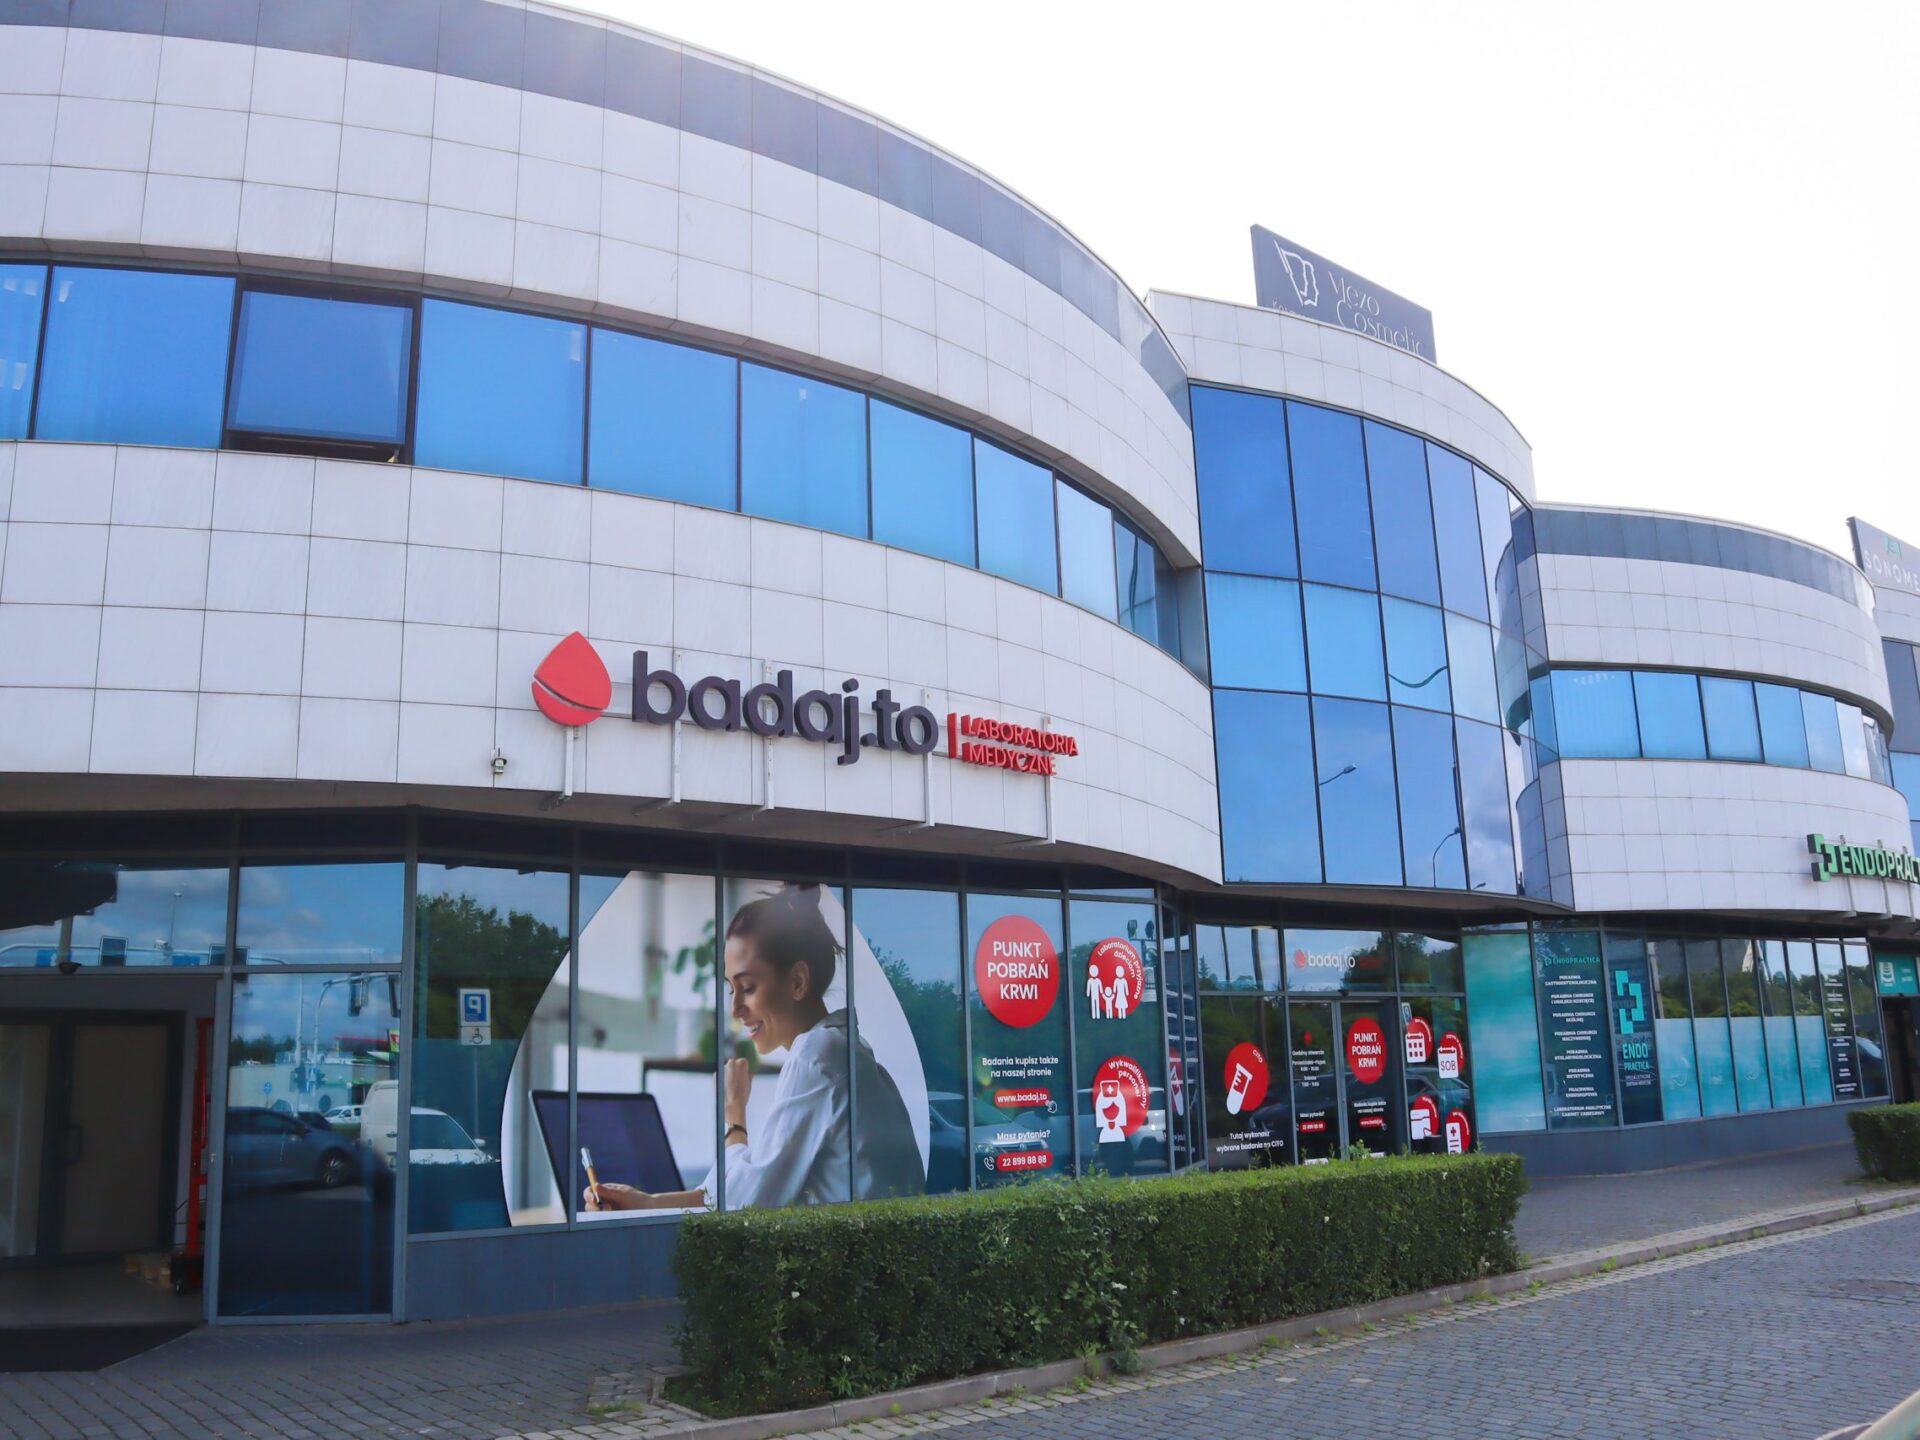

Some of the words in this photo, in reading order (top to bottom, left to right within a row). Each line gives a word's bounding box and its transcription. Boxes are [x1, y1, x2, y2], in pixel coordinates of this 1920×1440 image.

[632, 650, 939, 766] badaj.to
[961, 714, 1079, 757] LABORATORIA
[962, 741, 1057, 776] MEDYCZNE
[993, 941, 1042, 958] PUNKT
[1307, 951, 1356, 972] badaj.to
[987, 958, 1049, 980] POBRAŃ
[1000, 983, 1038, 1000] KRWI
[1354, 1032, 1378, 1043] PUNKT
[1351, 1042, 1382, 1056] POBRAŃ
[1622, 1043, 1649, 1060] ENDO
[982, 1057, 1014, 1066] Badania
[1015, 1056, 1038, 1067] kupisz
[1039, 1056, 1059, 1065] także
[1358, 1057, 1377, 1068] KRWI
[1440, 1060, 1457, 1072] SOB
[990, 1070, 1001, 1078] na
[1002, 1068, 1026, 1079] naszej
[1027, 1067, 1052, 1077] stronie
[997, 1092, 1048, 1103] www.badaj.to
[996, 1132, 1017, 1141] Masz
[1017, 1129, 1051, 1142] pytania?
[1002, 1157, 1012, 1167] 22
